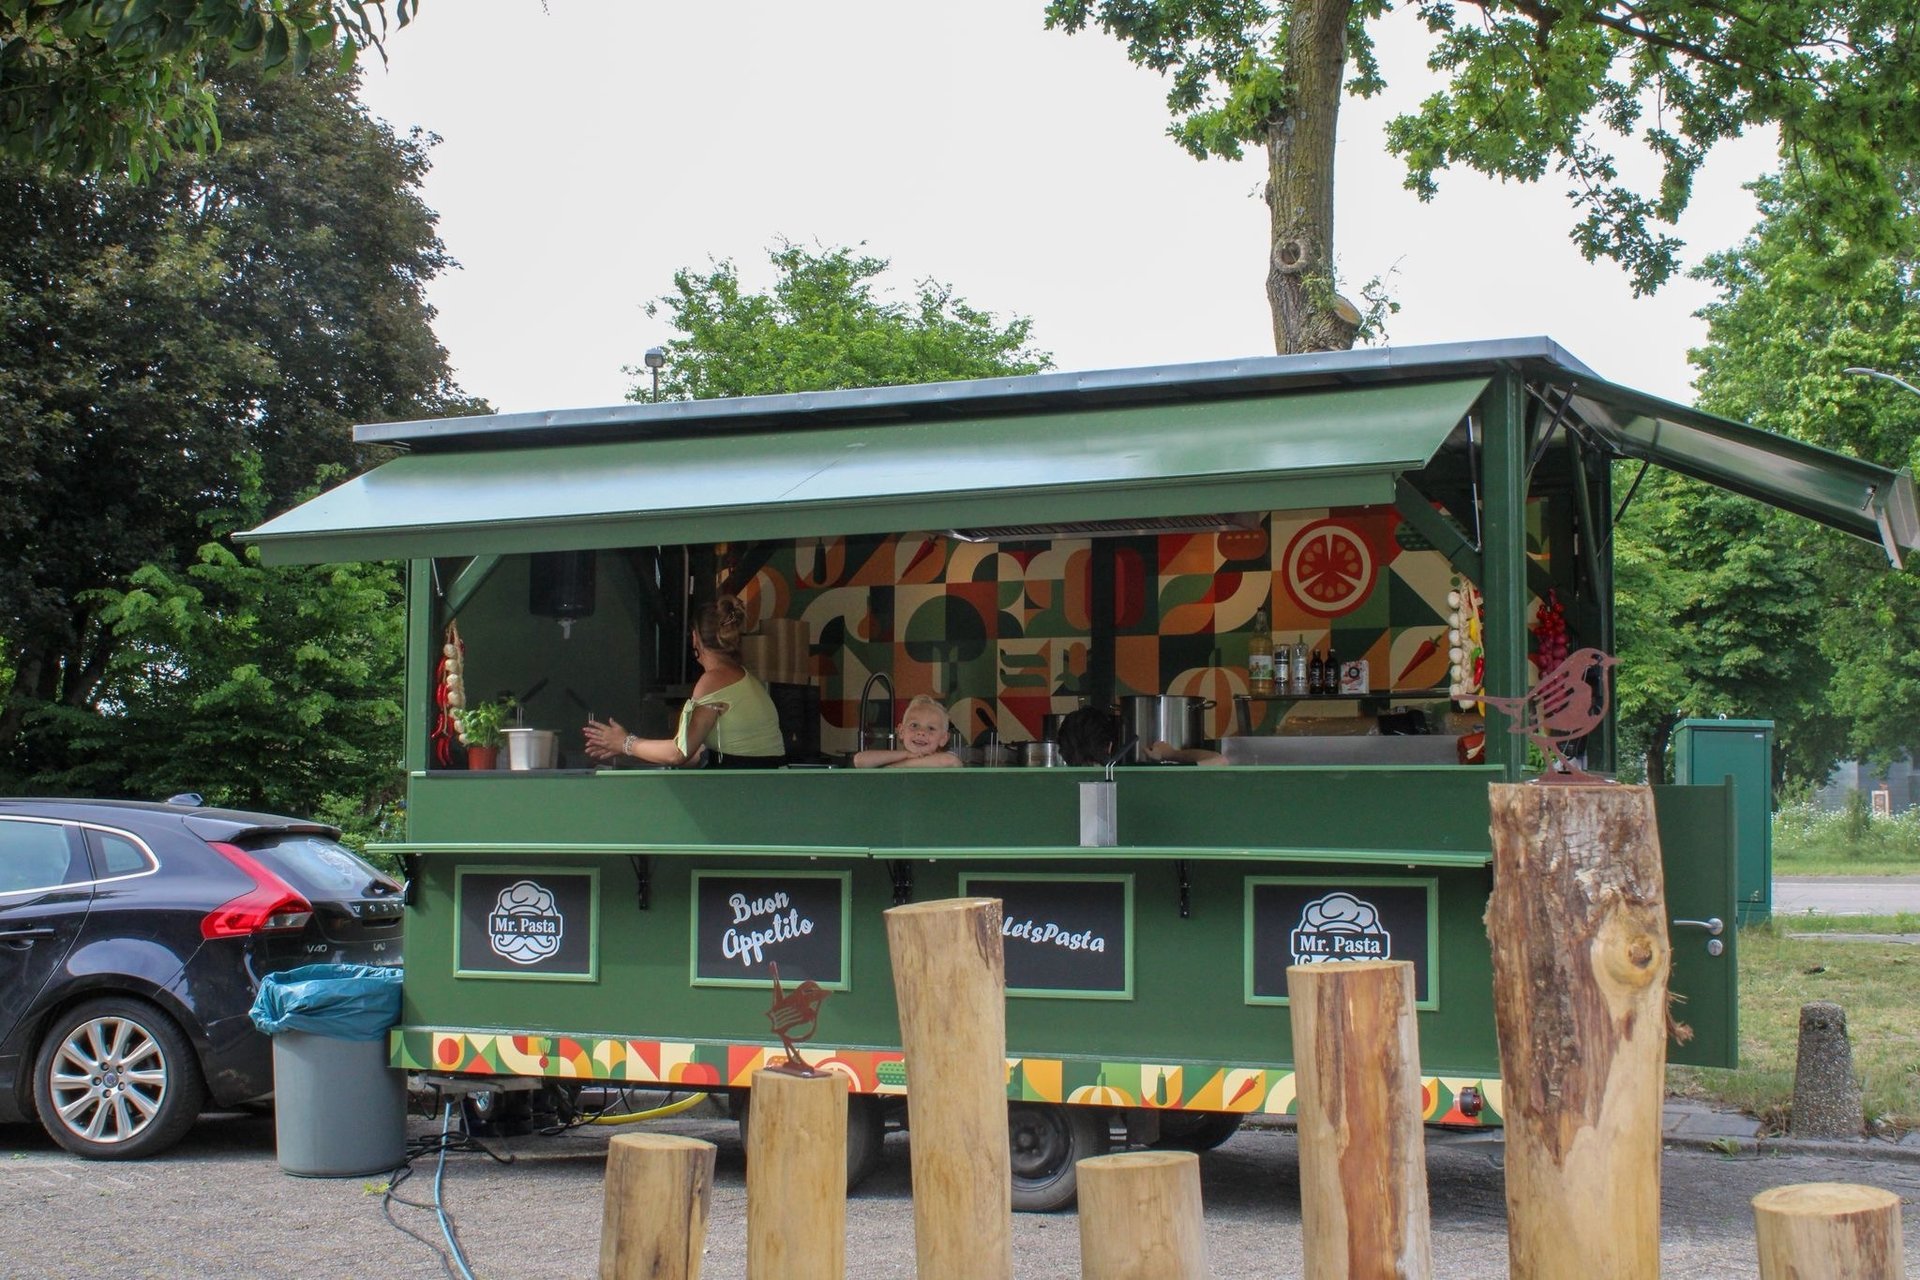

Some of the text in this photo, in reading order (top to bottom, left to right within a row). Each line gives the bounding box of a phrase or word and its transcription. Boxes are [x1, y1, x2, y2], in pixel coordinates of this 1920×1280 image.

[728, 891, 790, 925] Buon
[495, 917, 556, 934] Mr. Pasta
[722, 908, 814, 967] Appetito
[1300, 935, 1381, 954] Mr. Pasta
[306, 944, 328, 953] V40
